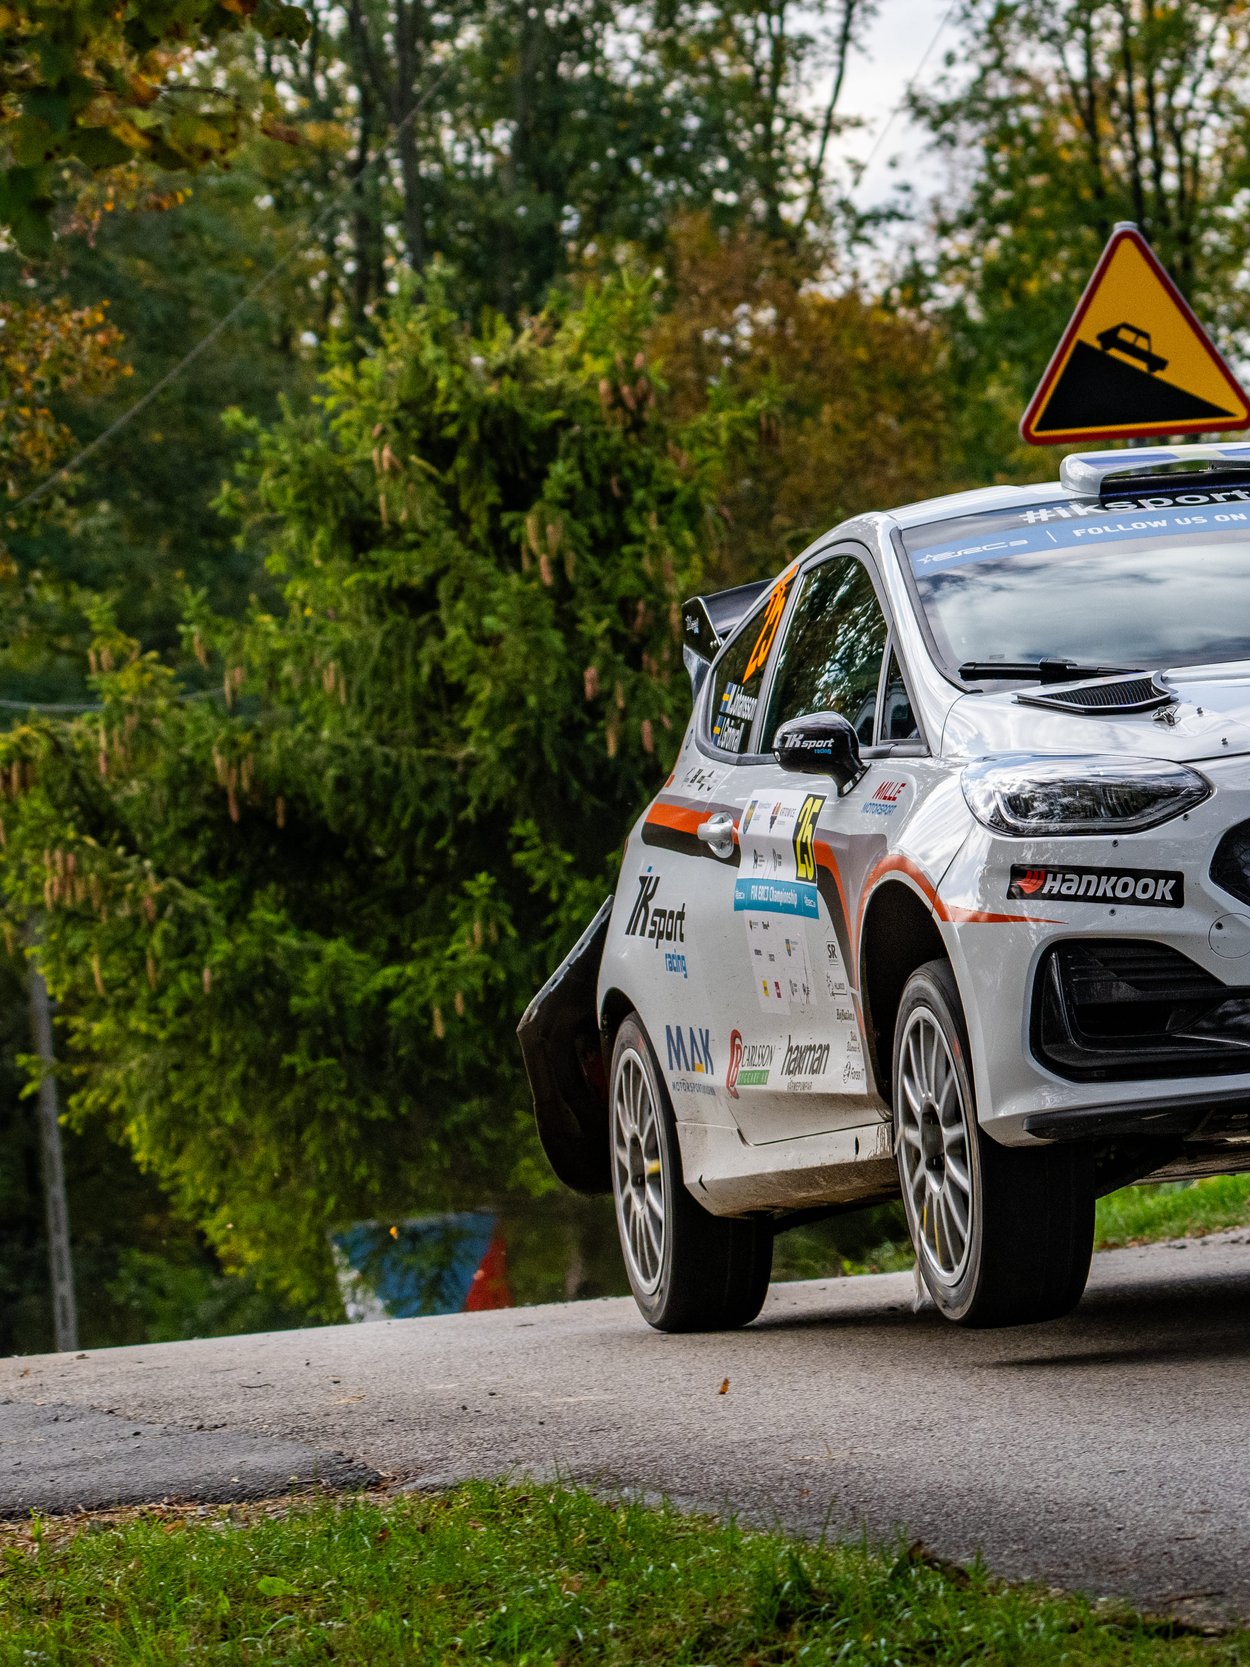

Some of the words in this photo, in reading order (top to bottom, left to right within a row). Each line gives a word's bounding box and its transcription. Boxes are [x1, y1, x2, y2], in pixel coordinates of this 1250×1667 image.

[1072, 519, 1168, 538] FOLLOW
[1174, 516, 1208, 526] US
[1214, 513, 1248, 522] ON
[872, 782, 907, 801] MILLE
[862, 801, 898, 815] MOTORSPORT
[797, 796, 824, 881] 25
[750, 885, 758, 901] FIA
[769, 886, 798, 908] Championship
[664, 948, 688, 979] racing
[665, 1025, 715, 1076] MAK
[741, 1044, 776, 1067] CARLSSON
[781, 1034, 831, 1076] haxman
